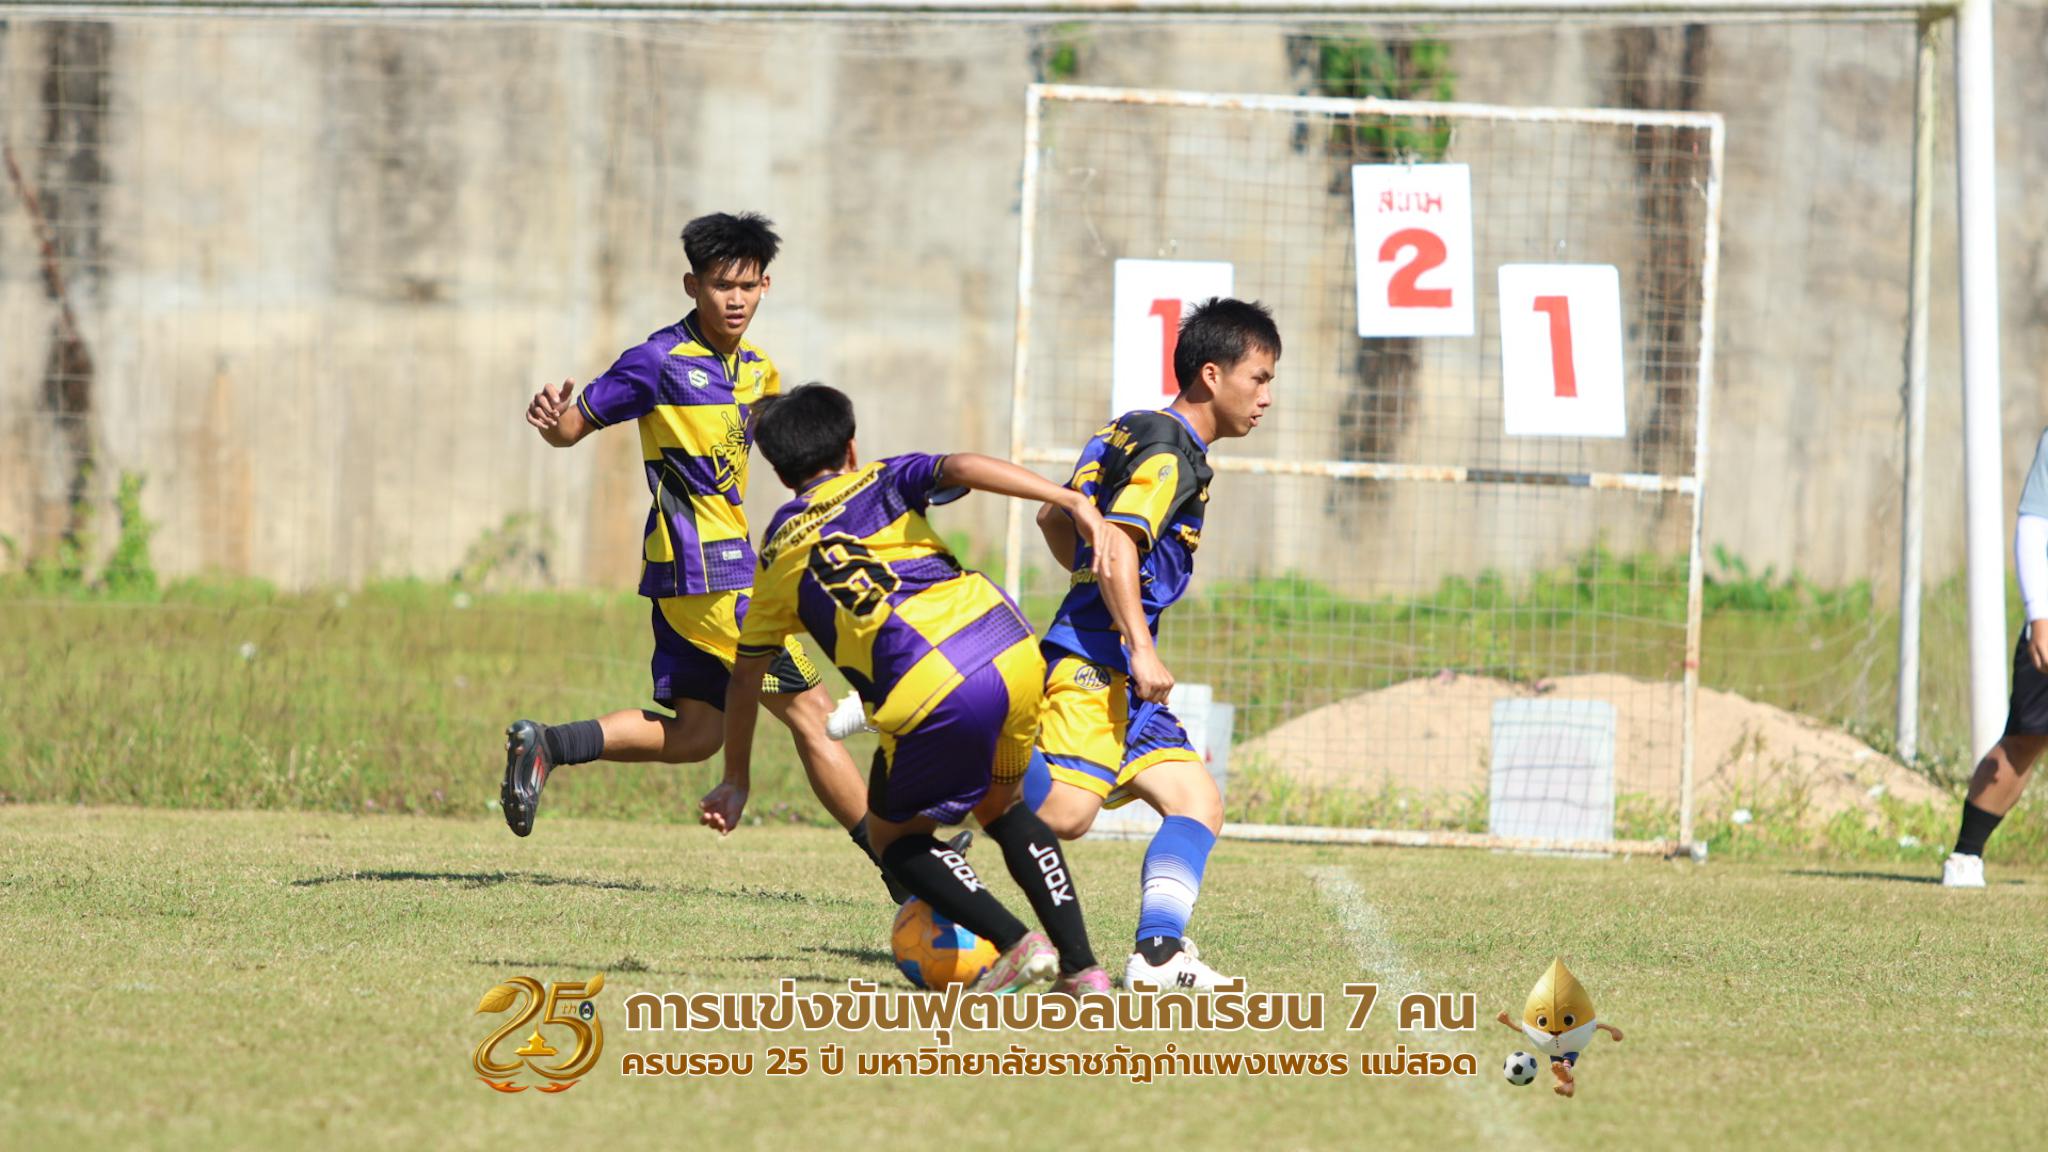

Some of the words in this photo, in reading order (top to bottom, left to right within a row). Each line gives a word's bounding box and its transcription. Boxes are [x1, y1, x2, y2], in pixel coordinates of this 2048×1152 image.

[1378, 228, 1453, 309] 2
[1149, 298, 1182, 397] 1
[1533, 295, 1578, 398] 1
[1028, 842, 1075, 907] JOOK
